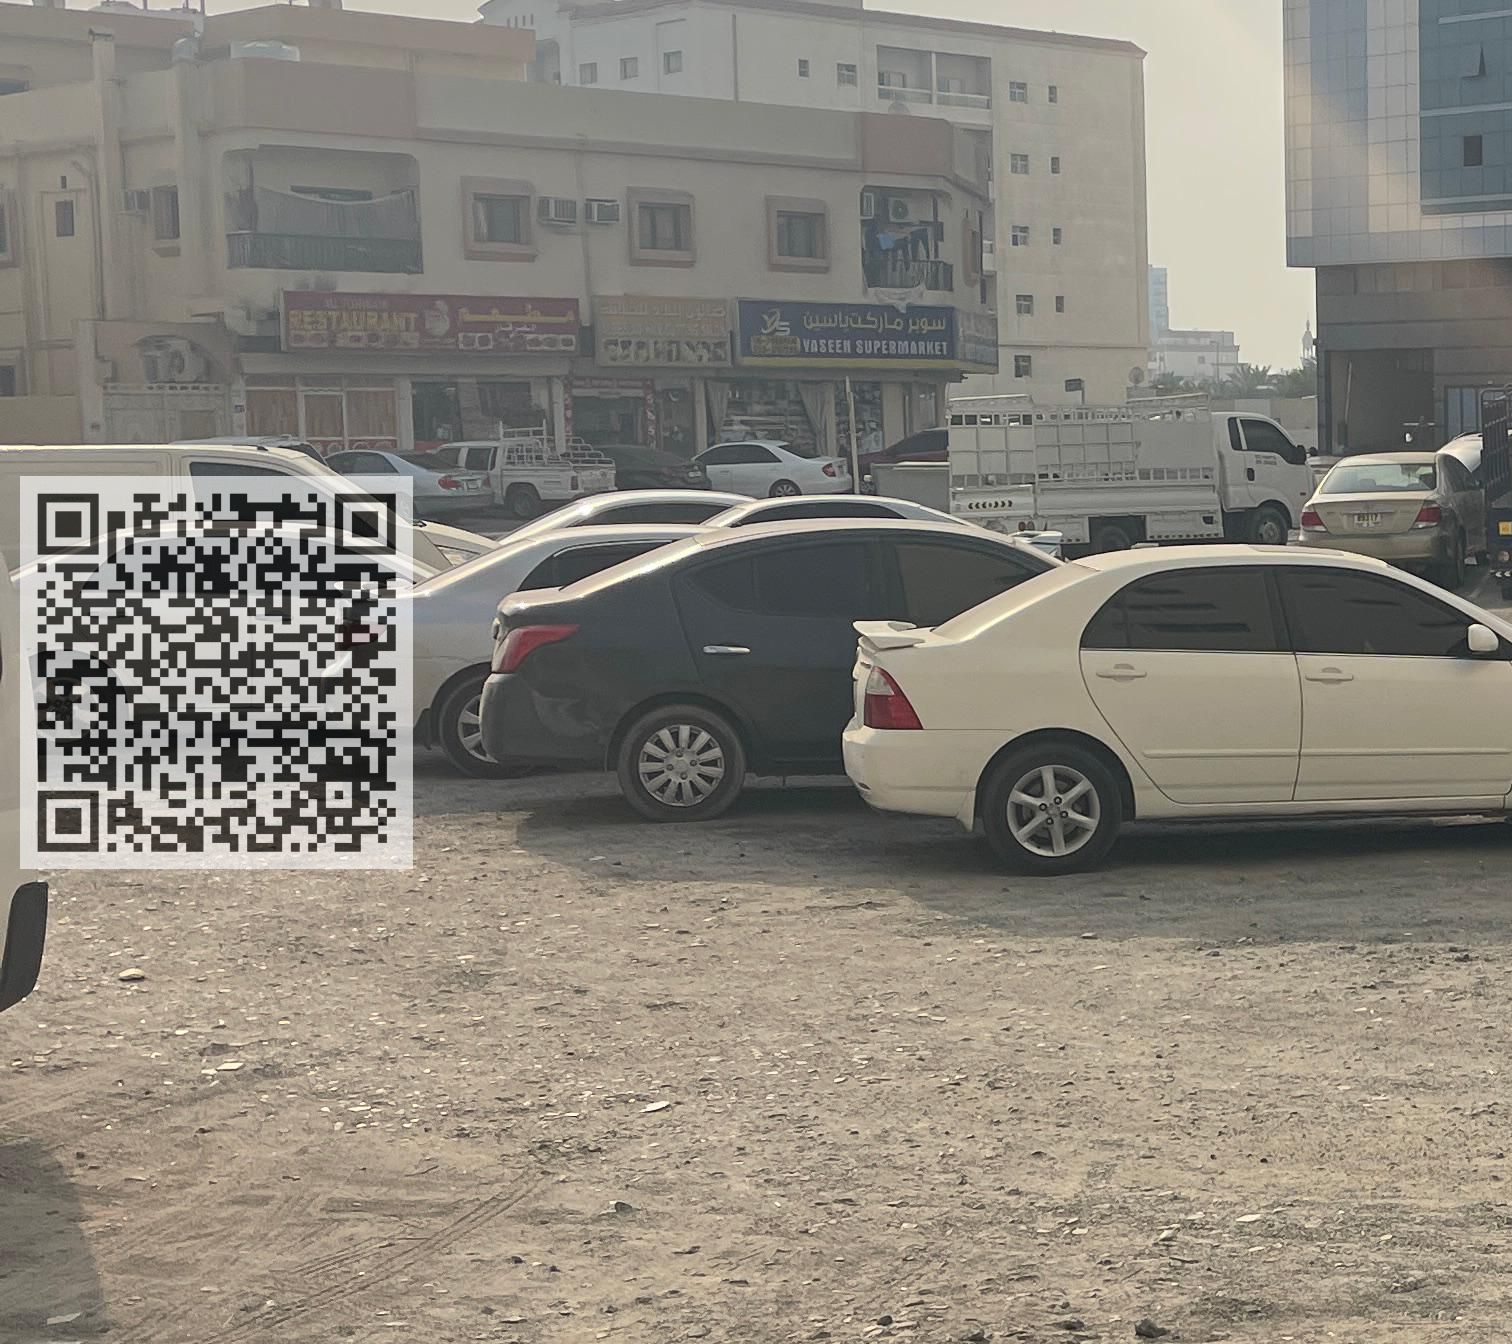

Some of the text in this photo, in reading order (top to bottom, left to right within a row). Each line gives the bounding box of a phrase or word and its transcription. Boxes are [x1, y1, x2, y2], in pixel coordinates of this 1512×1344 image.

[289, 310, 417, 330] RESTAURANT
[803, 338, 851, 354] YASEEN
[856, 339, 948, 355] SUPERMARKET
